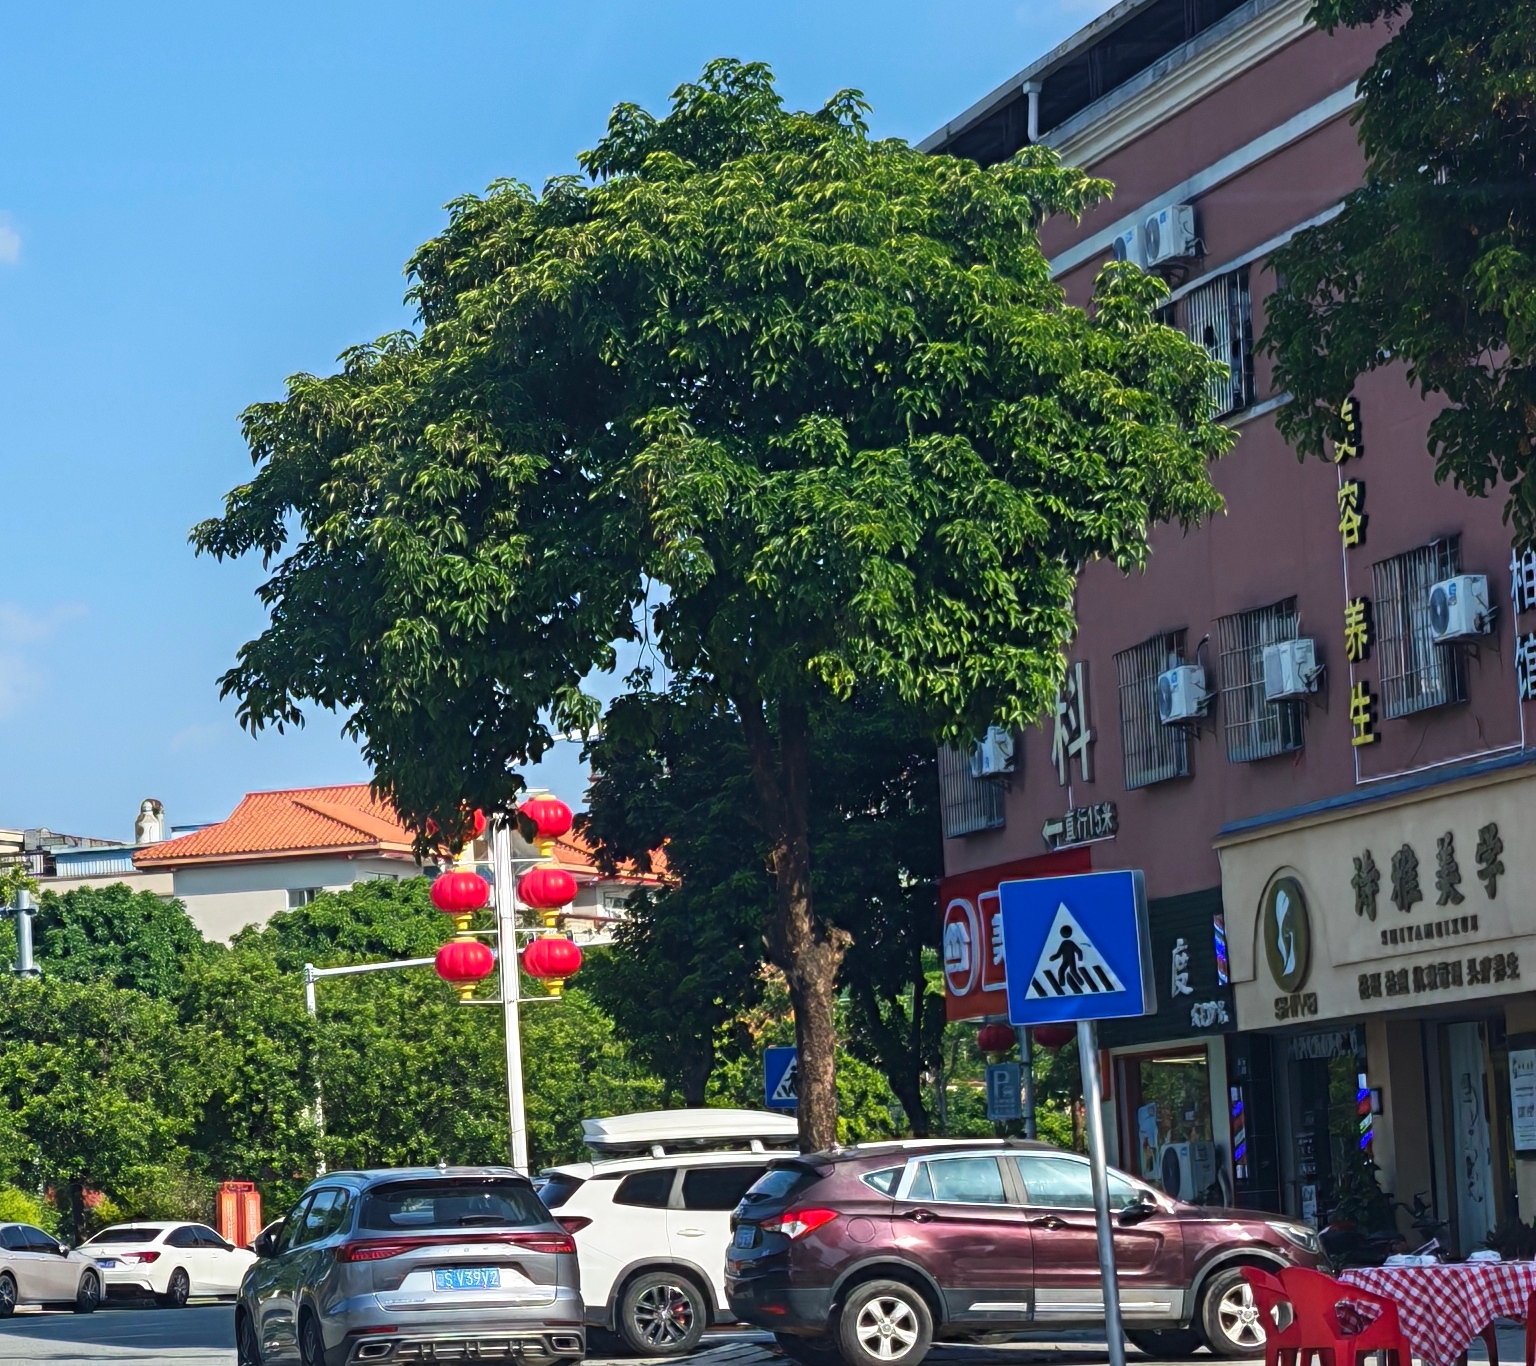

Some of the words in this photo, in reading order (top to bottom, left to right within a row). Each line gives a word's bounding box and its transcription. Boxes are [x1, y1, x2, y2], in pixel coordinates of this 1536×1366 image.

[1344, 597, 1376, 747] 养生
[1051, 661, 1091, 786] 科
[1064, 801, 1114, 842] 直行15米
[1351, 822, 1505, 922] 诗雅美学
[1171, 938, 1193, 998] 度
[994, 1071, 1009, 1098] P
